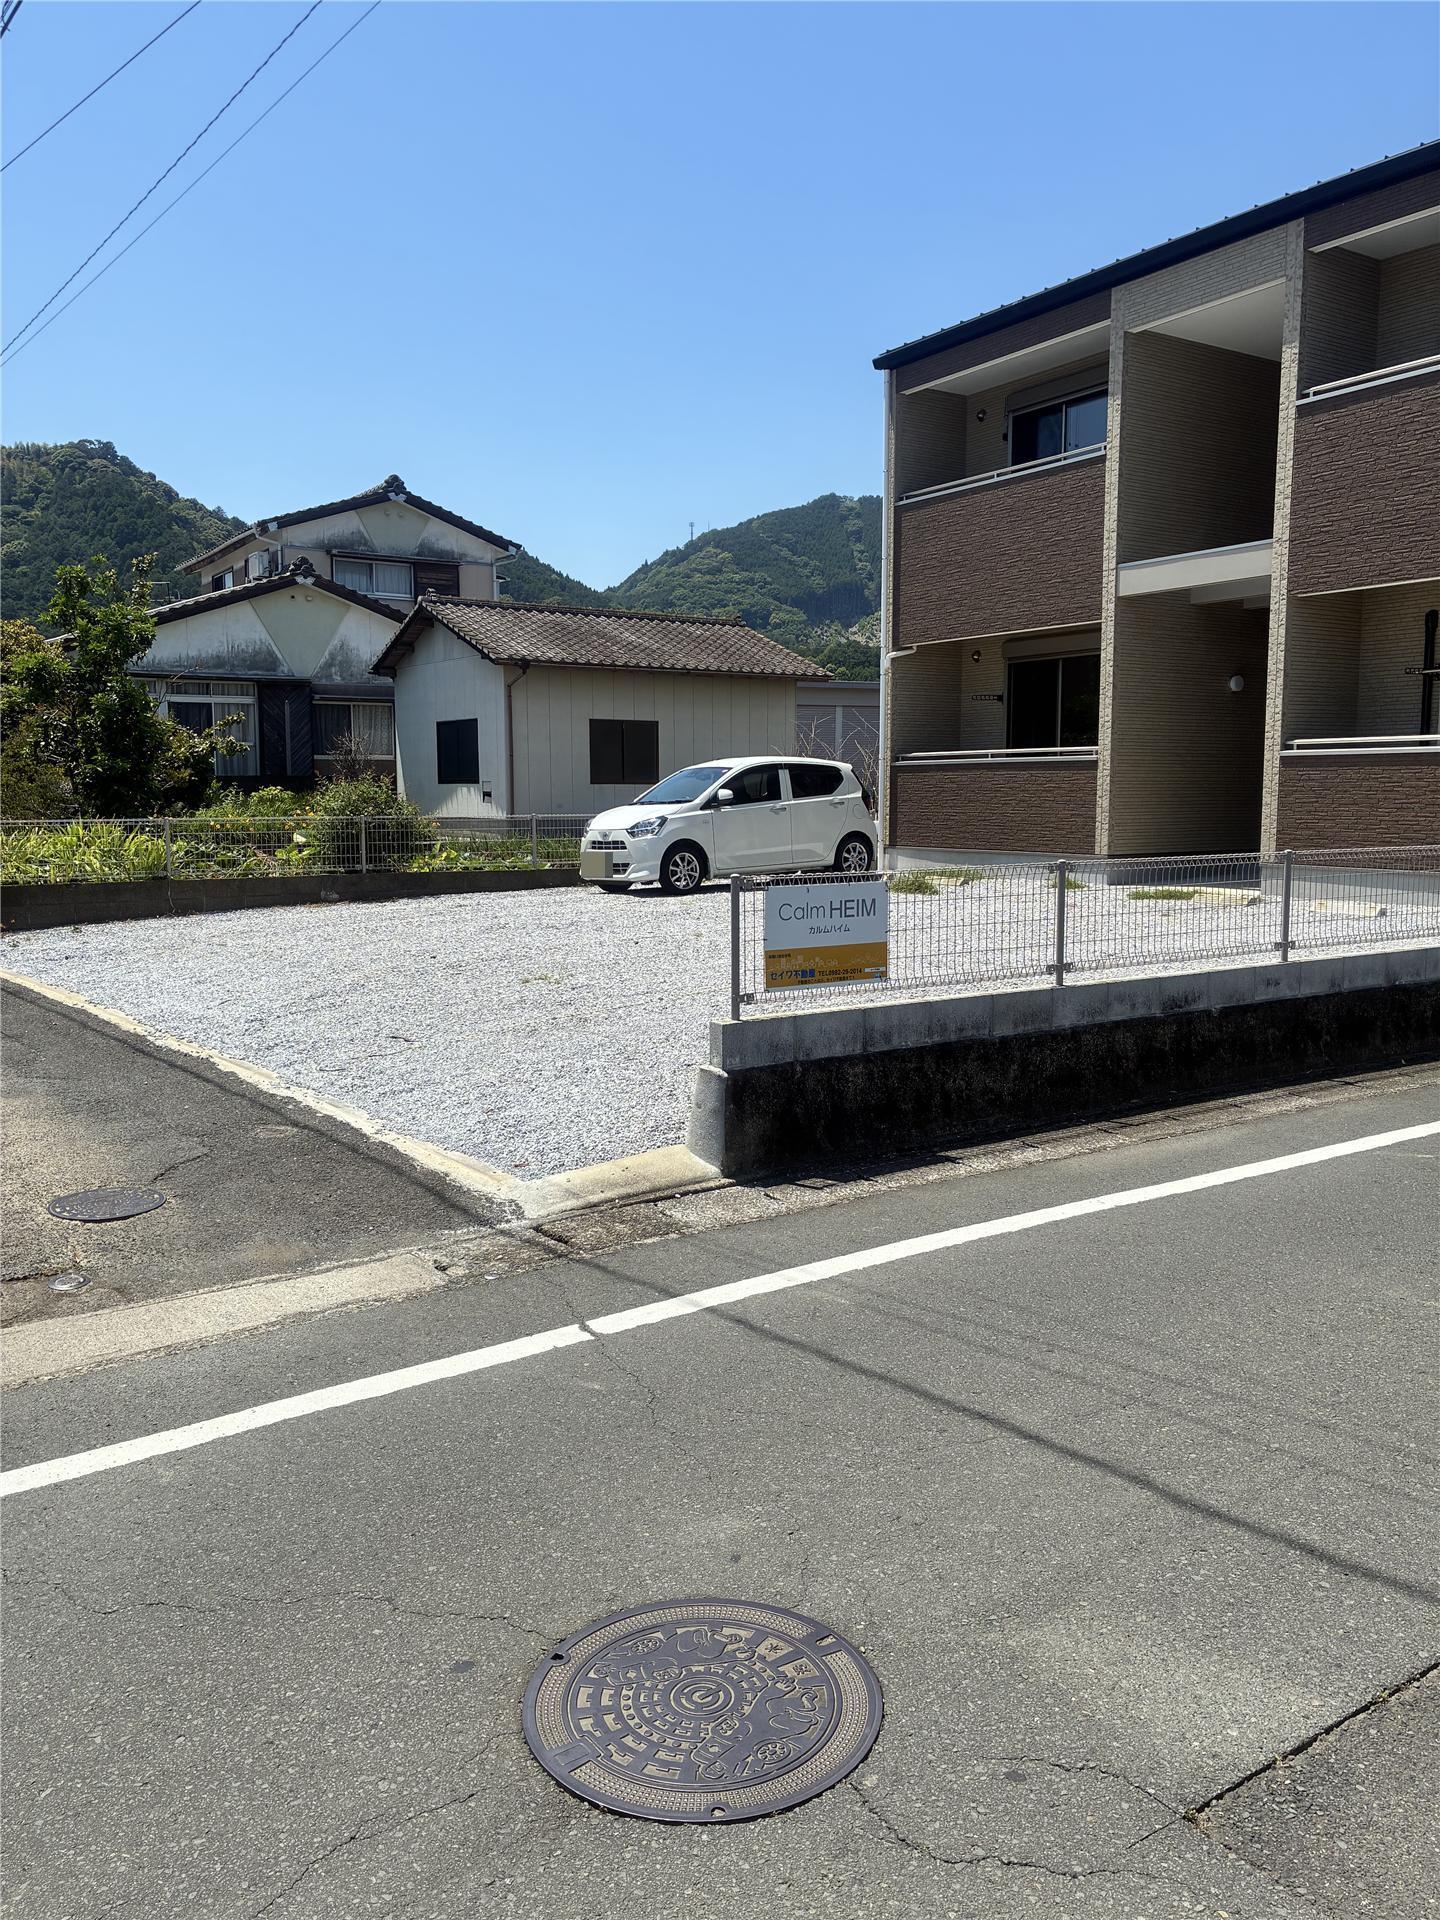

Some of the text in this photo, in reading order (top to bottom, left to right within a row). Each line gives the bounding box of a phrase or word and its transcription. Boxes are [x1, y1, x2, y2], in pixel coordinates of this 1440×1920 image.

[778, 898, 877, 921] Calm HEIM
[808, 923, 851, 935] カルムハイム
[770, 968, 816, 981] セイワ不
